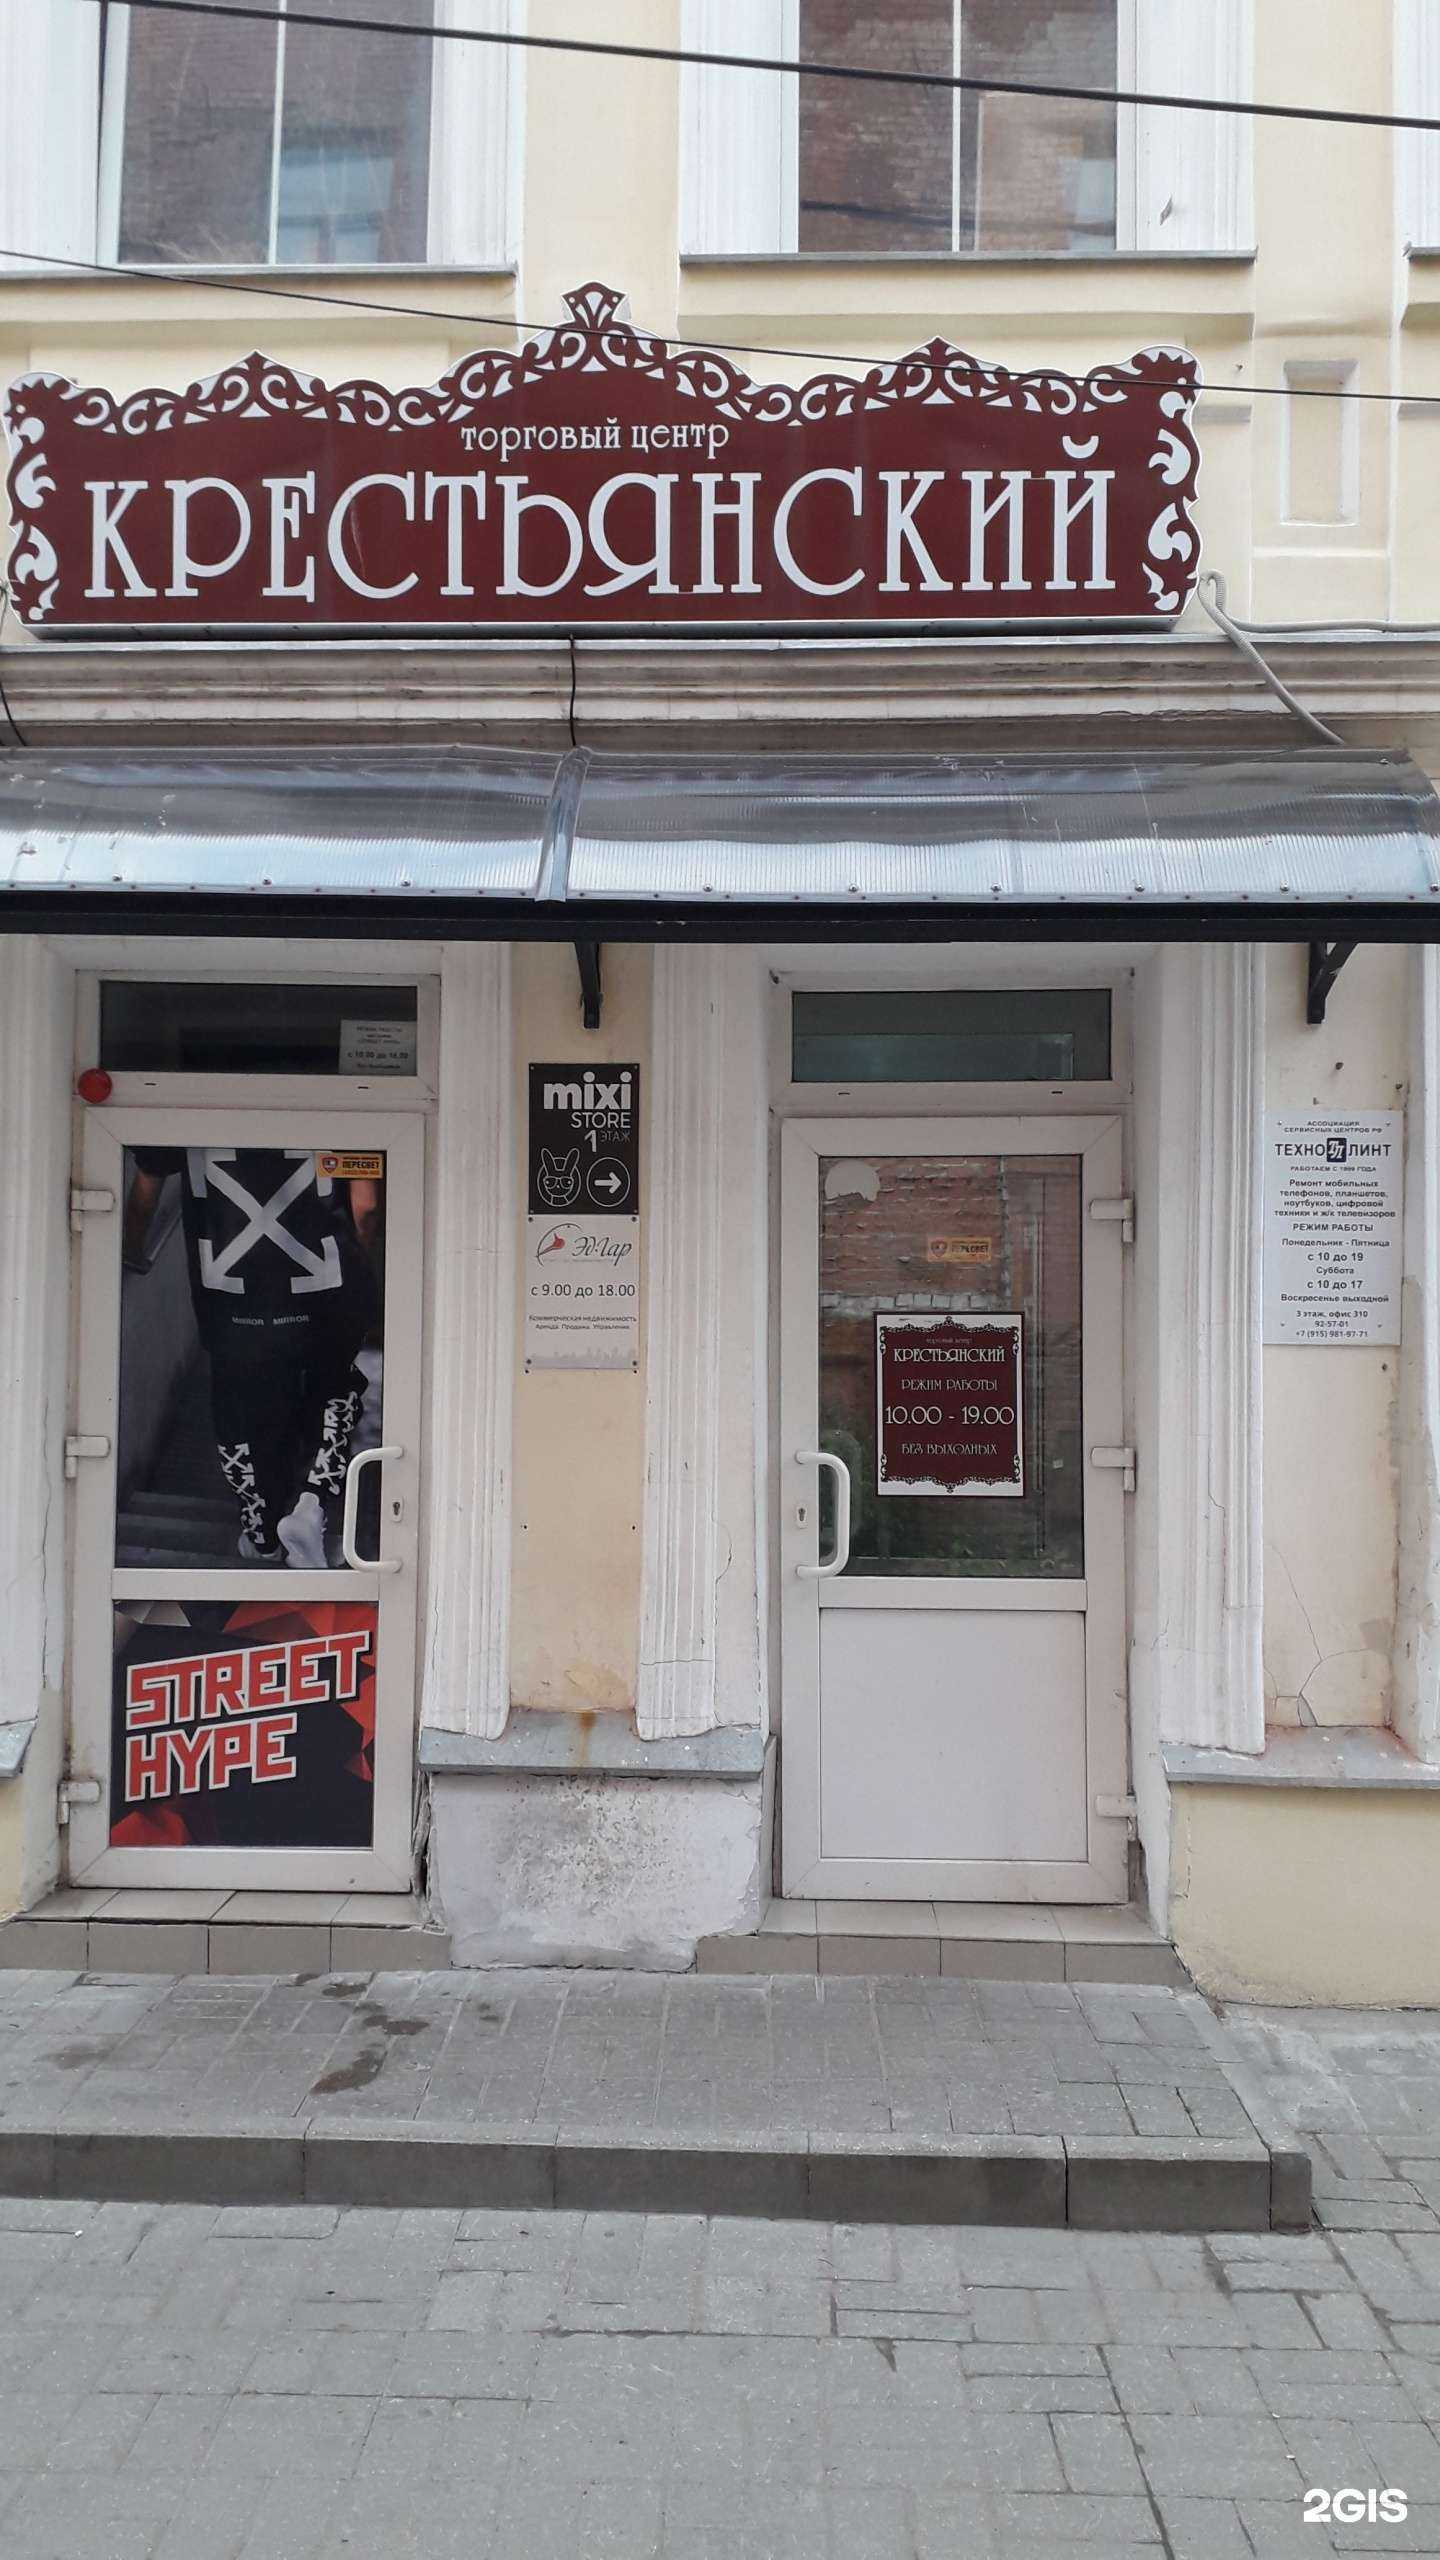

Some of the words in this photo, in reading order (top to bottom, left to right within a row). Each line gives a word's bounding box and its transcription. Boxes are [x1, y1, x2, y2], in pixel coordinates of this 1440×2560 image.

[461, 417, 621, 462] торговый
[631, 423, 729, 459] центр
[83, 434, 1116, 603] КРЕСТЬЯНСКИЙ
[543, 1071, 632, 1110] mixi
[570, 1111, 631, 1128] STORE
[584, 1129, 597, 1153] 1
[600, 1130, 631, 1143] ЭТАЖ
[1289, 1179, 1322, 1187] Ремонт
[1280, 1190, 1333, 1198] телефонов,
[1284, 1200, 1334, 1208] ноутбуков,
[1336, 1200, 1384, 1208] цифровой
[1337, 1210, 1396, 1218] телевизоров
[1293, 1223, 1329, 1231] РЕЖИМ
[1332, 1223, 1374, 1232] РАБОТЫ
[1282, 1238, 1343, 1247] Понедельник
[1351, 1239, 1390, 1248] Пятница
[1307, 1253, 1314, 1261] с
[1318, 1252, 1330, 1261] 10
[1333, 1253, 1348, 1262] до
[1351, 1252, 1364, 1261] 19
[1316, 1266, 1354, 1275] Суббота
[531, 1286, 539, 1296] с
[542, 1284, 572, 1297] 9.00
[574, 1286, 594, 1298] до
[598, 1284, 636, 1297] 18.00
[1307, 1281, 1314, 1289] с
[1317, 1280, 1330, 1289] 10
[1332, 1281, 1347, 1290] до
[1351, 1280, 1363, 1289] 17
[1281, 1294, 1340, 1302] Воскресенье
[1342, 1295, 1389, 1303] выходной
[1307, 1330, 1328, 1338] (915)
[894, 1346, 1005, 1362] КРЕСТЬЯНСКИЙ
[901, 1379, 942, 1391] РЕЖИМ
[946, 1379, 998, 1391] РАБОТЫ
[885, 1406, 942, 1425] 10.00
[960, 1406, 1015, 1425] 19.00
[902, 1443, 924, 1455] БЕЗ
[927, 1443, 998, 1455] ВЫХОДНЫХ
[125, 1630, 372, 1731] STREET
[125, 1713, 297, 1802] HYPE
